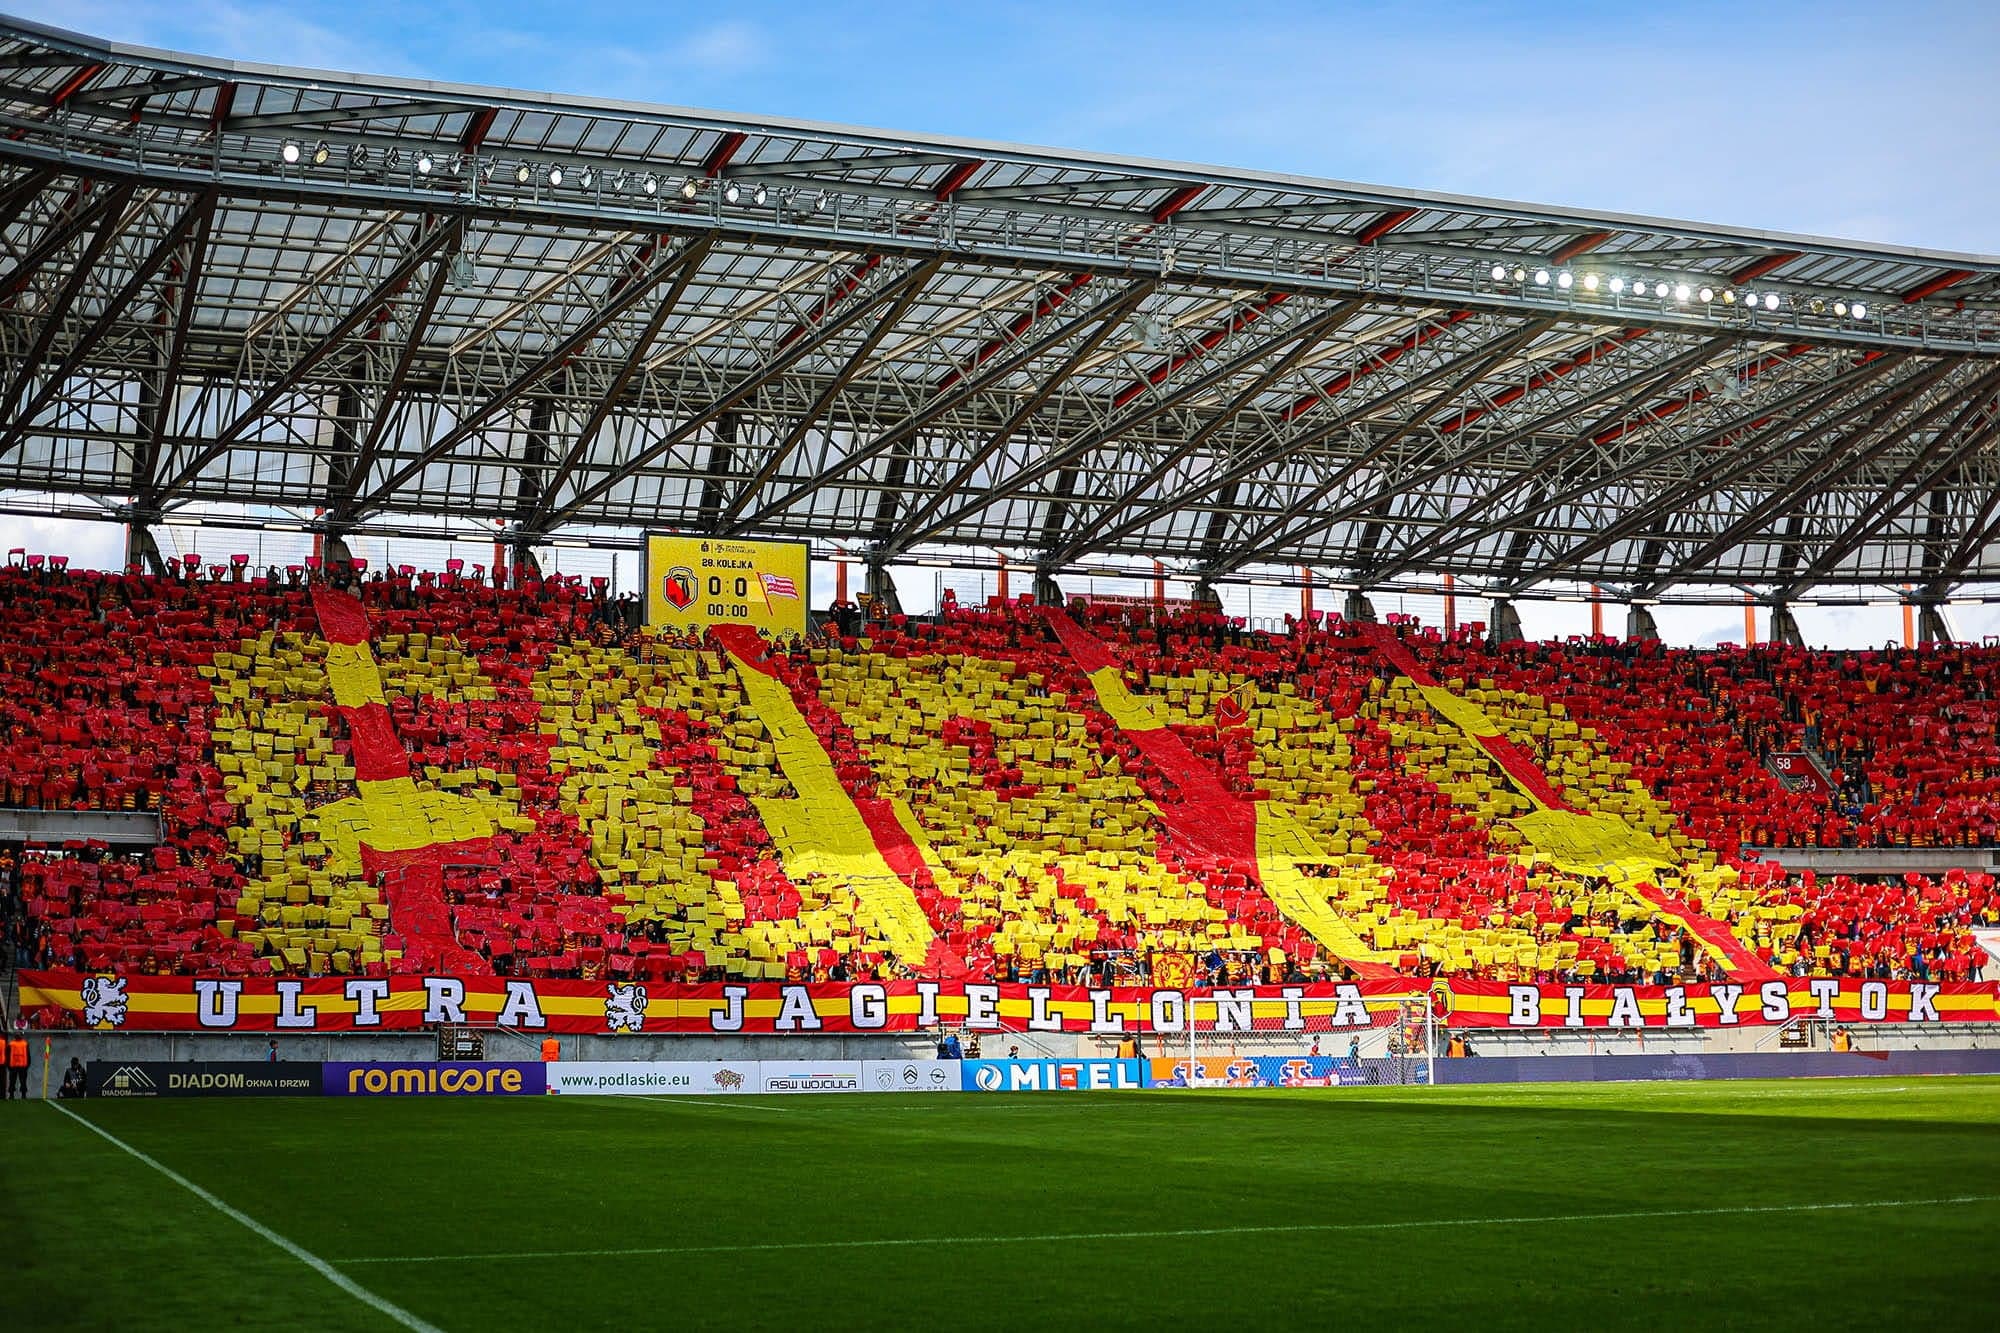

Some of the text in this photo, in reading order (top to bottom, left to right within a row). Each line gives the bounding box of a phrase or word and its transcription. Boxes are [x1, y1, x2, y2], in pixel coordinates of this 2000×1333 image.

[717, 559, 753, 570] KOLEJKA
[1777, 758, 1791, 770] 58
[195, 977, 1940, 1031] ULTRA JAGIELLONIA BIAŁYSTOK
[168, 1073, 244, 1089] DIADOM
[246, 1079, 273, 1088] OKNA
[279, 1079, 310, 1088] DRZWI
[348, 1068, 522, 1093] romicore
[561, 1073, 690, 1089] www.podlaskie.eu
[770, 1080, 798, 1089] ASW
